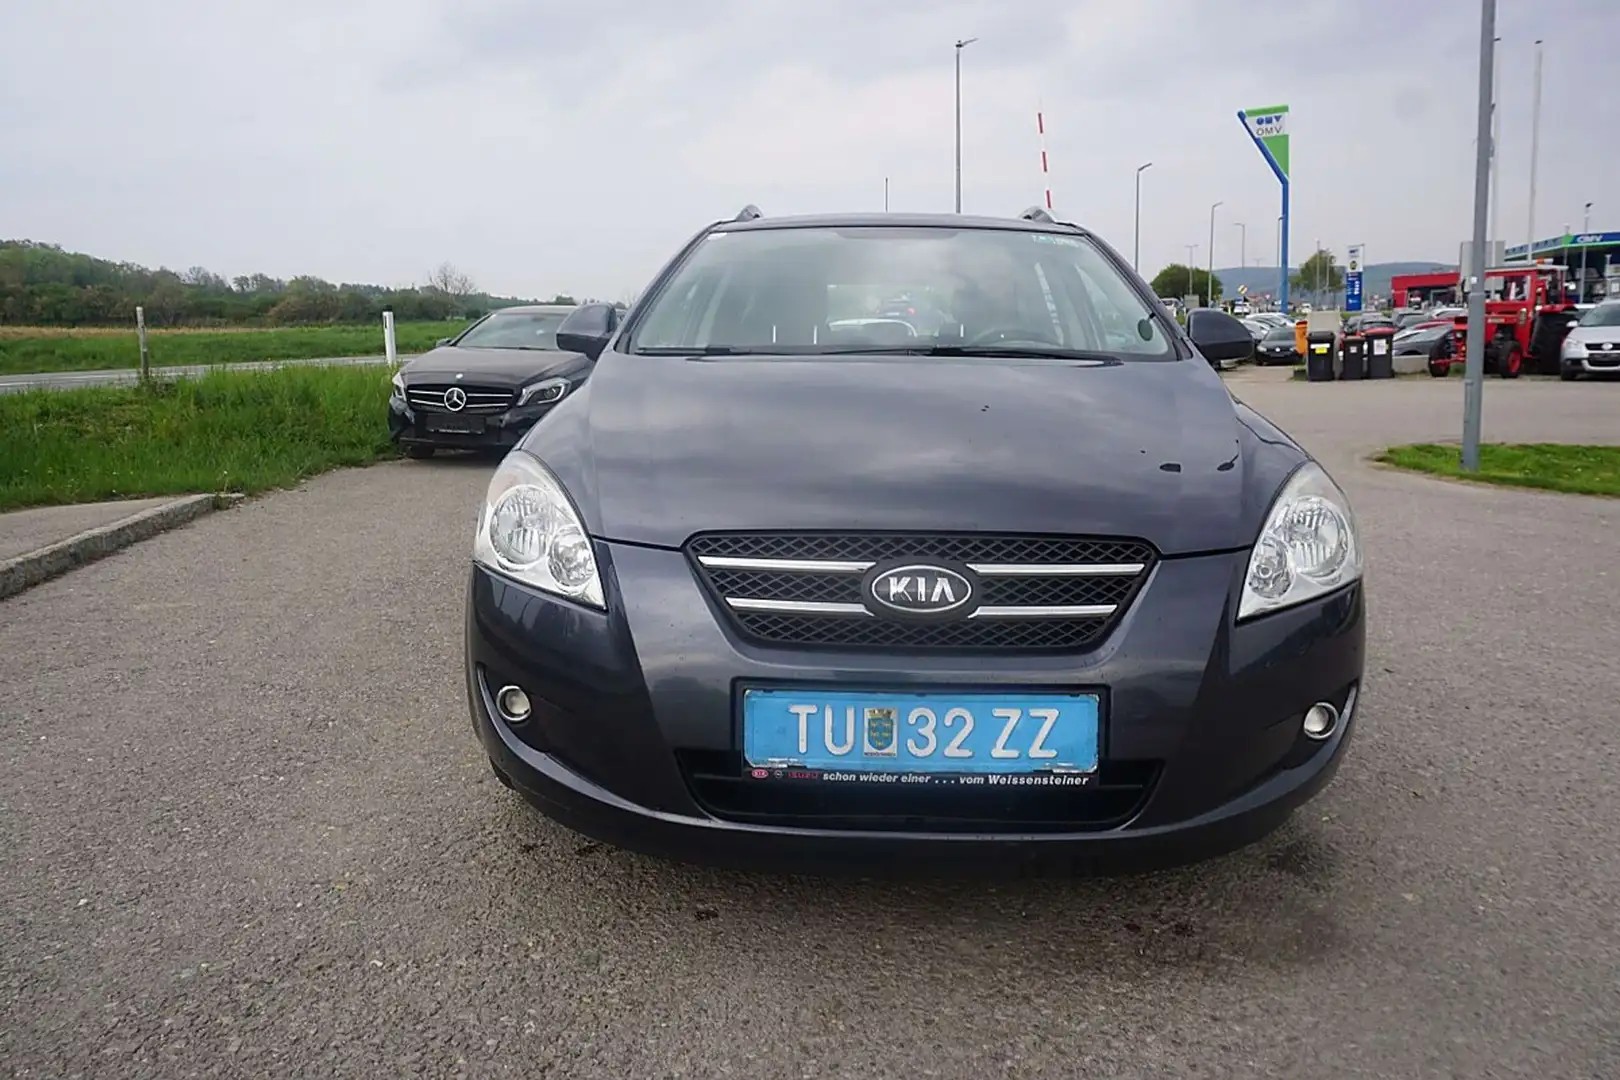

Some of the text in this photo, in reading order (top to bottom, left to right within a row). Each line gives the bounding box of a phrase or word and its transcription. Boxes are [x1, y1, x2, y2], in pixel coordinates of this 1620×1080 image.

[1256, 126, 1282, 136] OMV
[888, 577, 955, 602] KIA
[788, 704, 1060, 759] TU 32 ZZ
[823, 772, 856, 782] schon
[859, 773, 897, 783] wieder
[901, 774, 930, 784] einer
[959, 776, 984, 784] vom
[988, 775, 1089, 786] Weissensteiner
